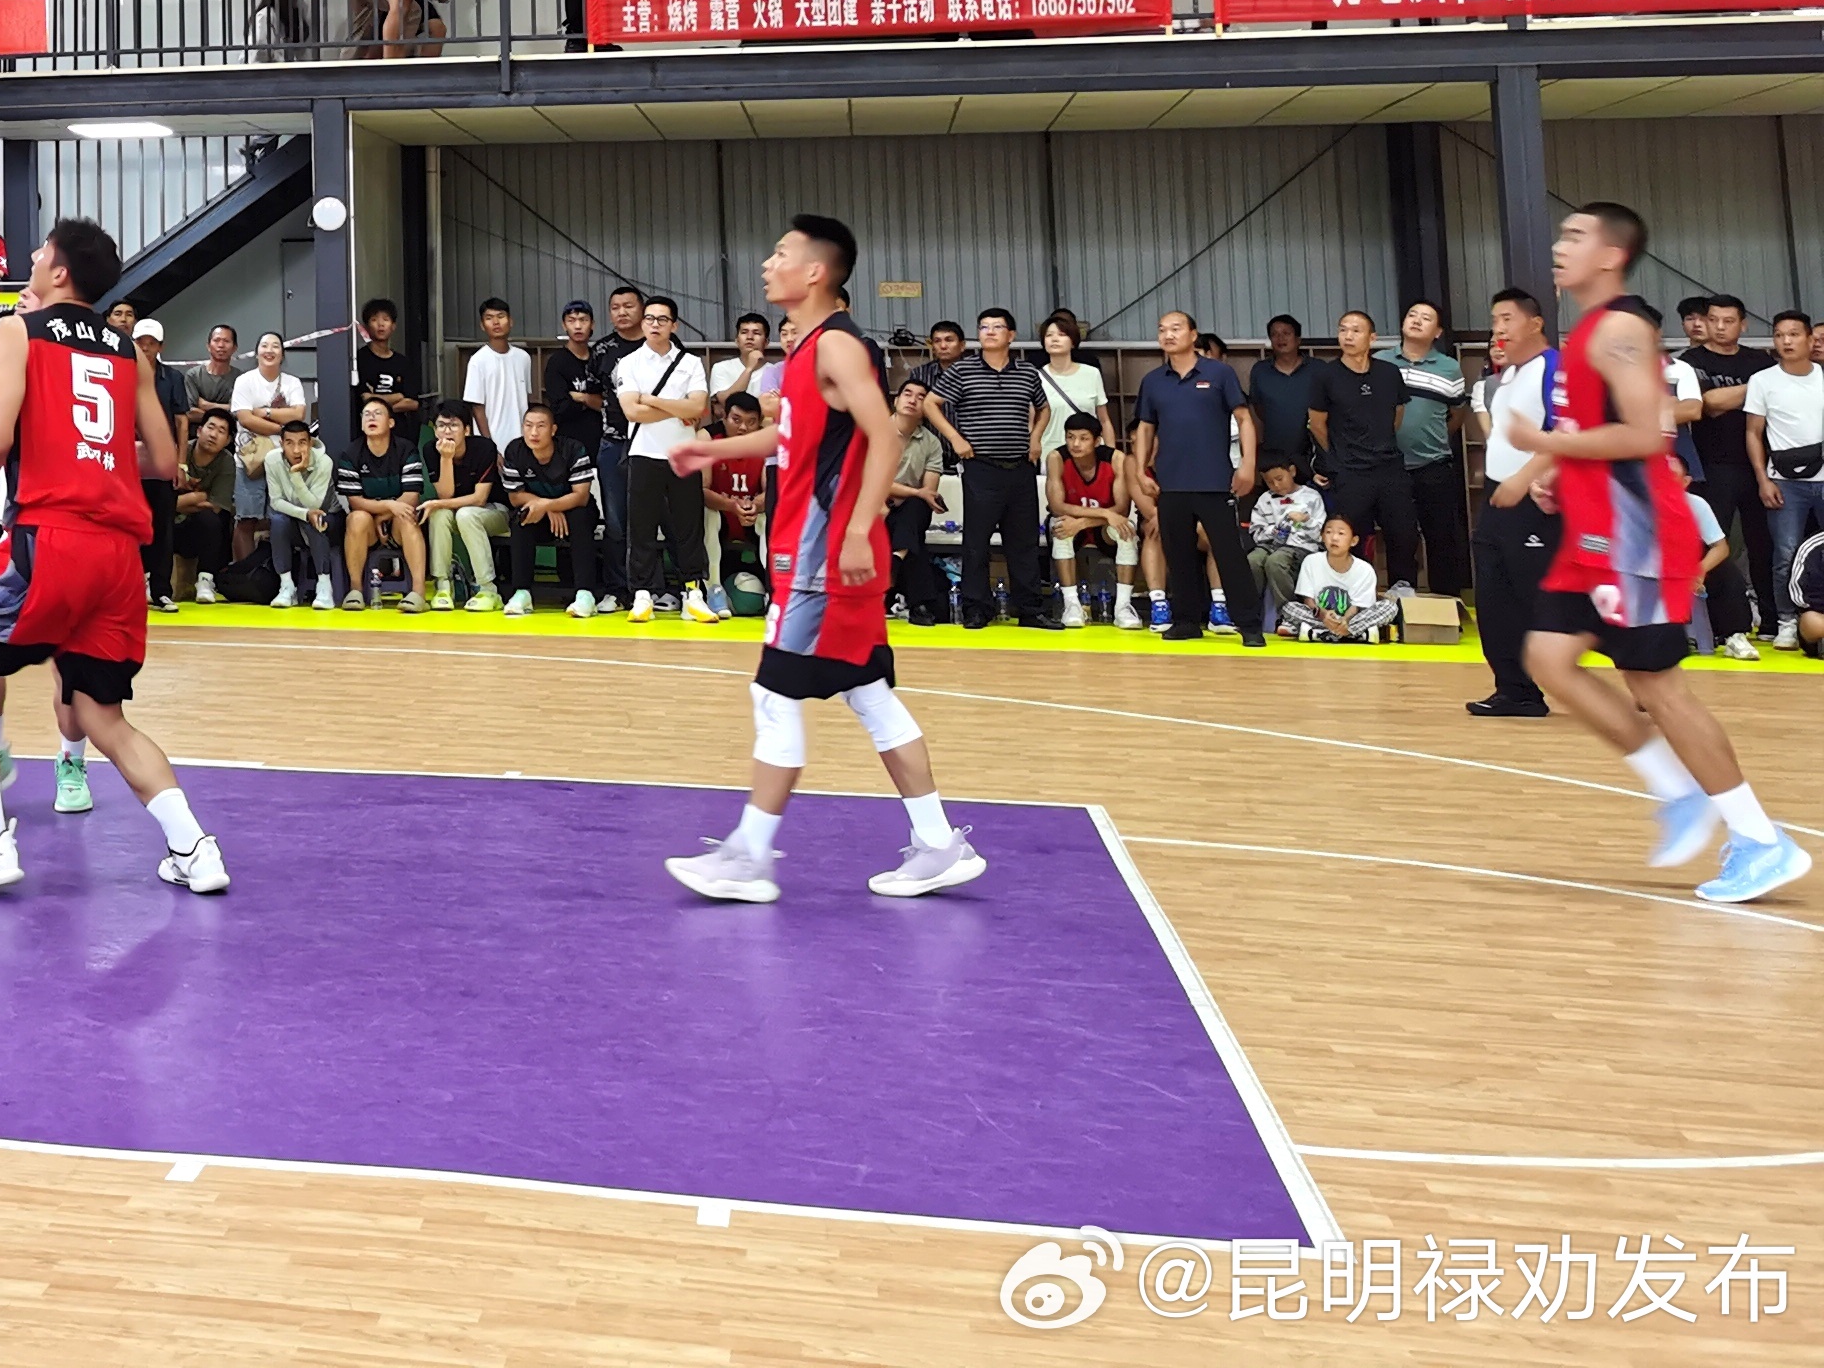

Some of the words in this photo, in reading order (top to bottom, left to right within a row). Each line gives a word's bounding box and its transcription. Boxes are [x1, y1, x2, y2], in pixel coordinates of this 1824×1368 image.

[46, 317, 121, 353] 茂山镇
[70, 352, 115, 444] 5
[731, 473, 749, 492] 11
